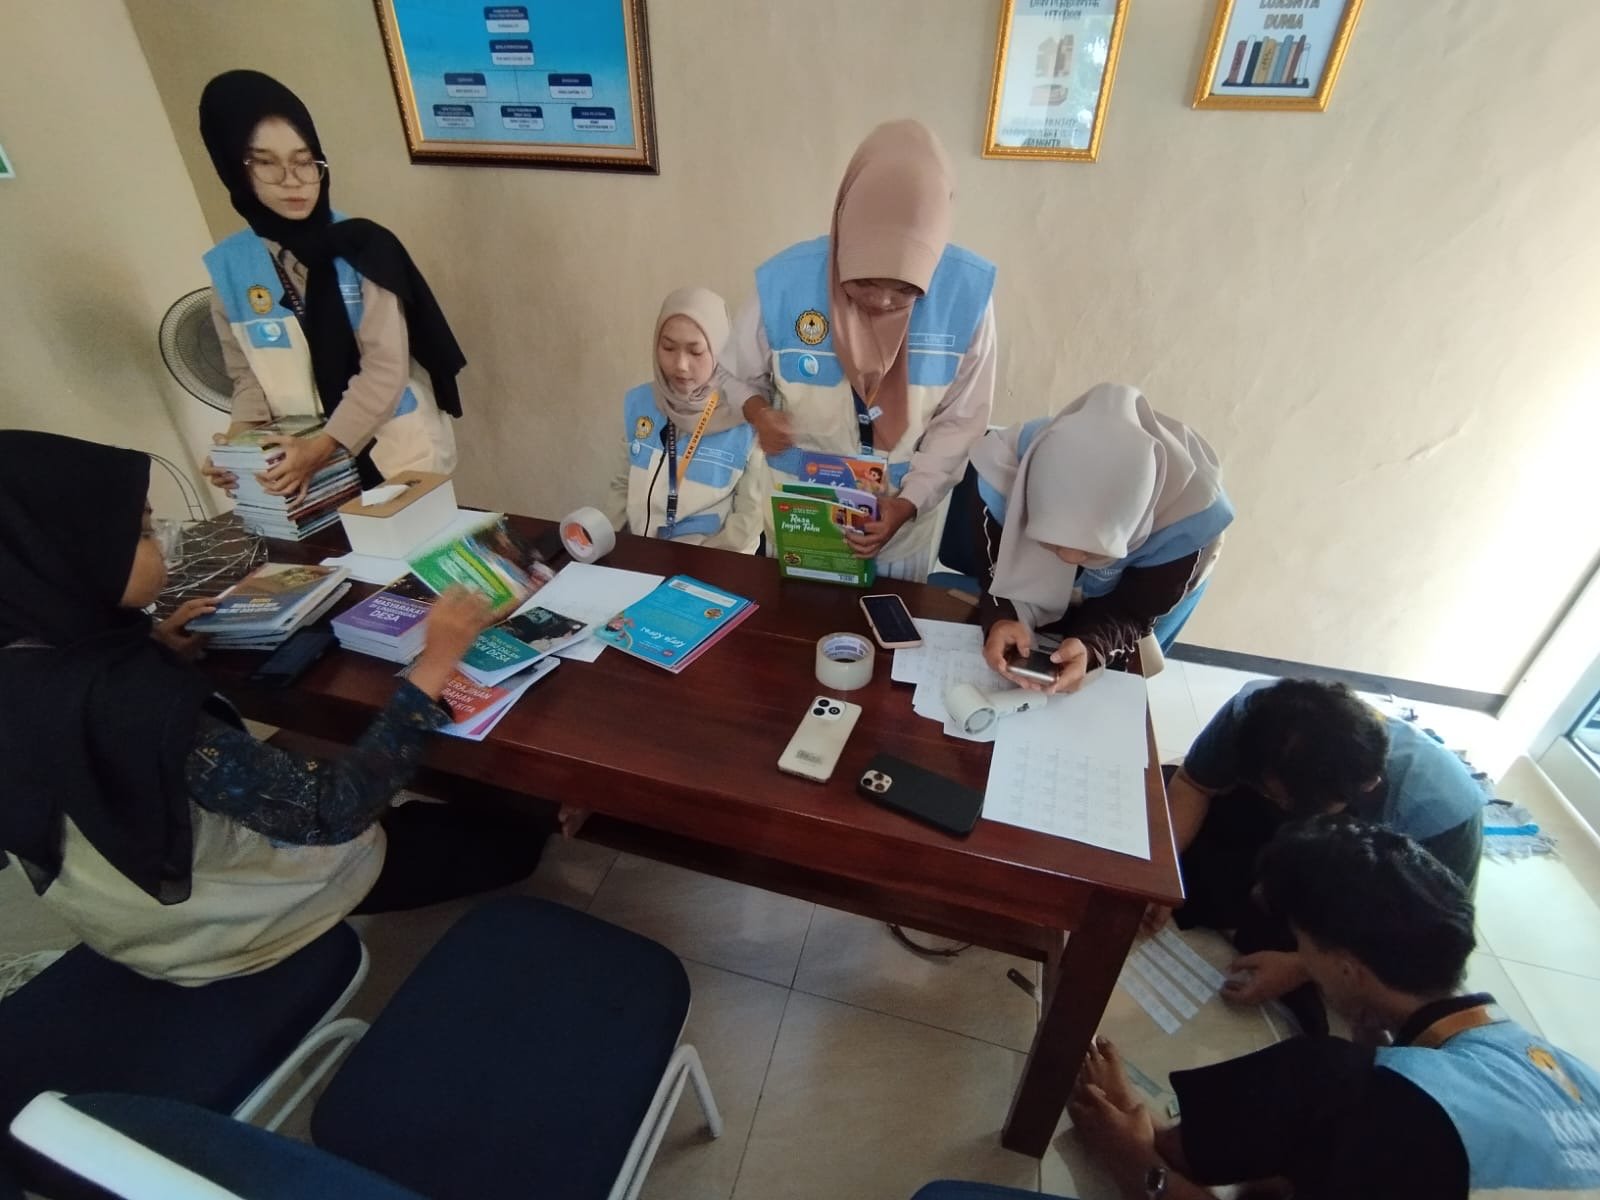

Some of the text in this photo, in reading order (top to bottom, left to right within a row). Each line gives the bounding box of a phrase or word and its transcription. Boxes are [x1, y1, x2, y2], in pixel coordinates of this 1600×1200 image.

[1263, 13, 1304, 29] DUNIA
[684, 445, 696, 459] KKN
[790, 513, 810, 525] Rasa
[781, 522, 820, 532] Ingin Tahu
[372, 598, 425, 615] MASYARAKAT
[369, 609, 400, 622] DESA
[664, 635, 687, 648] Kerja
[486, 647, 512, 662] DESA
